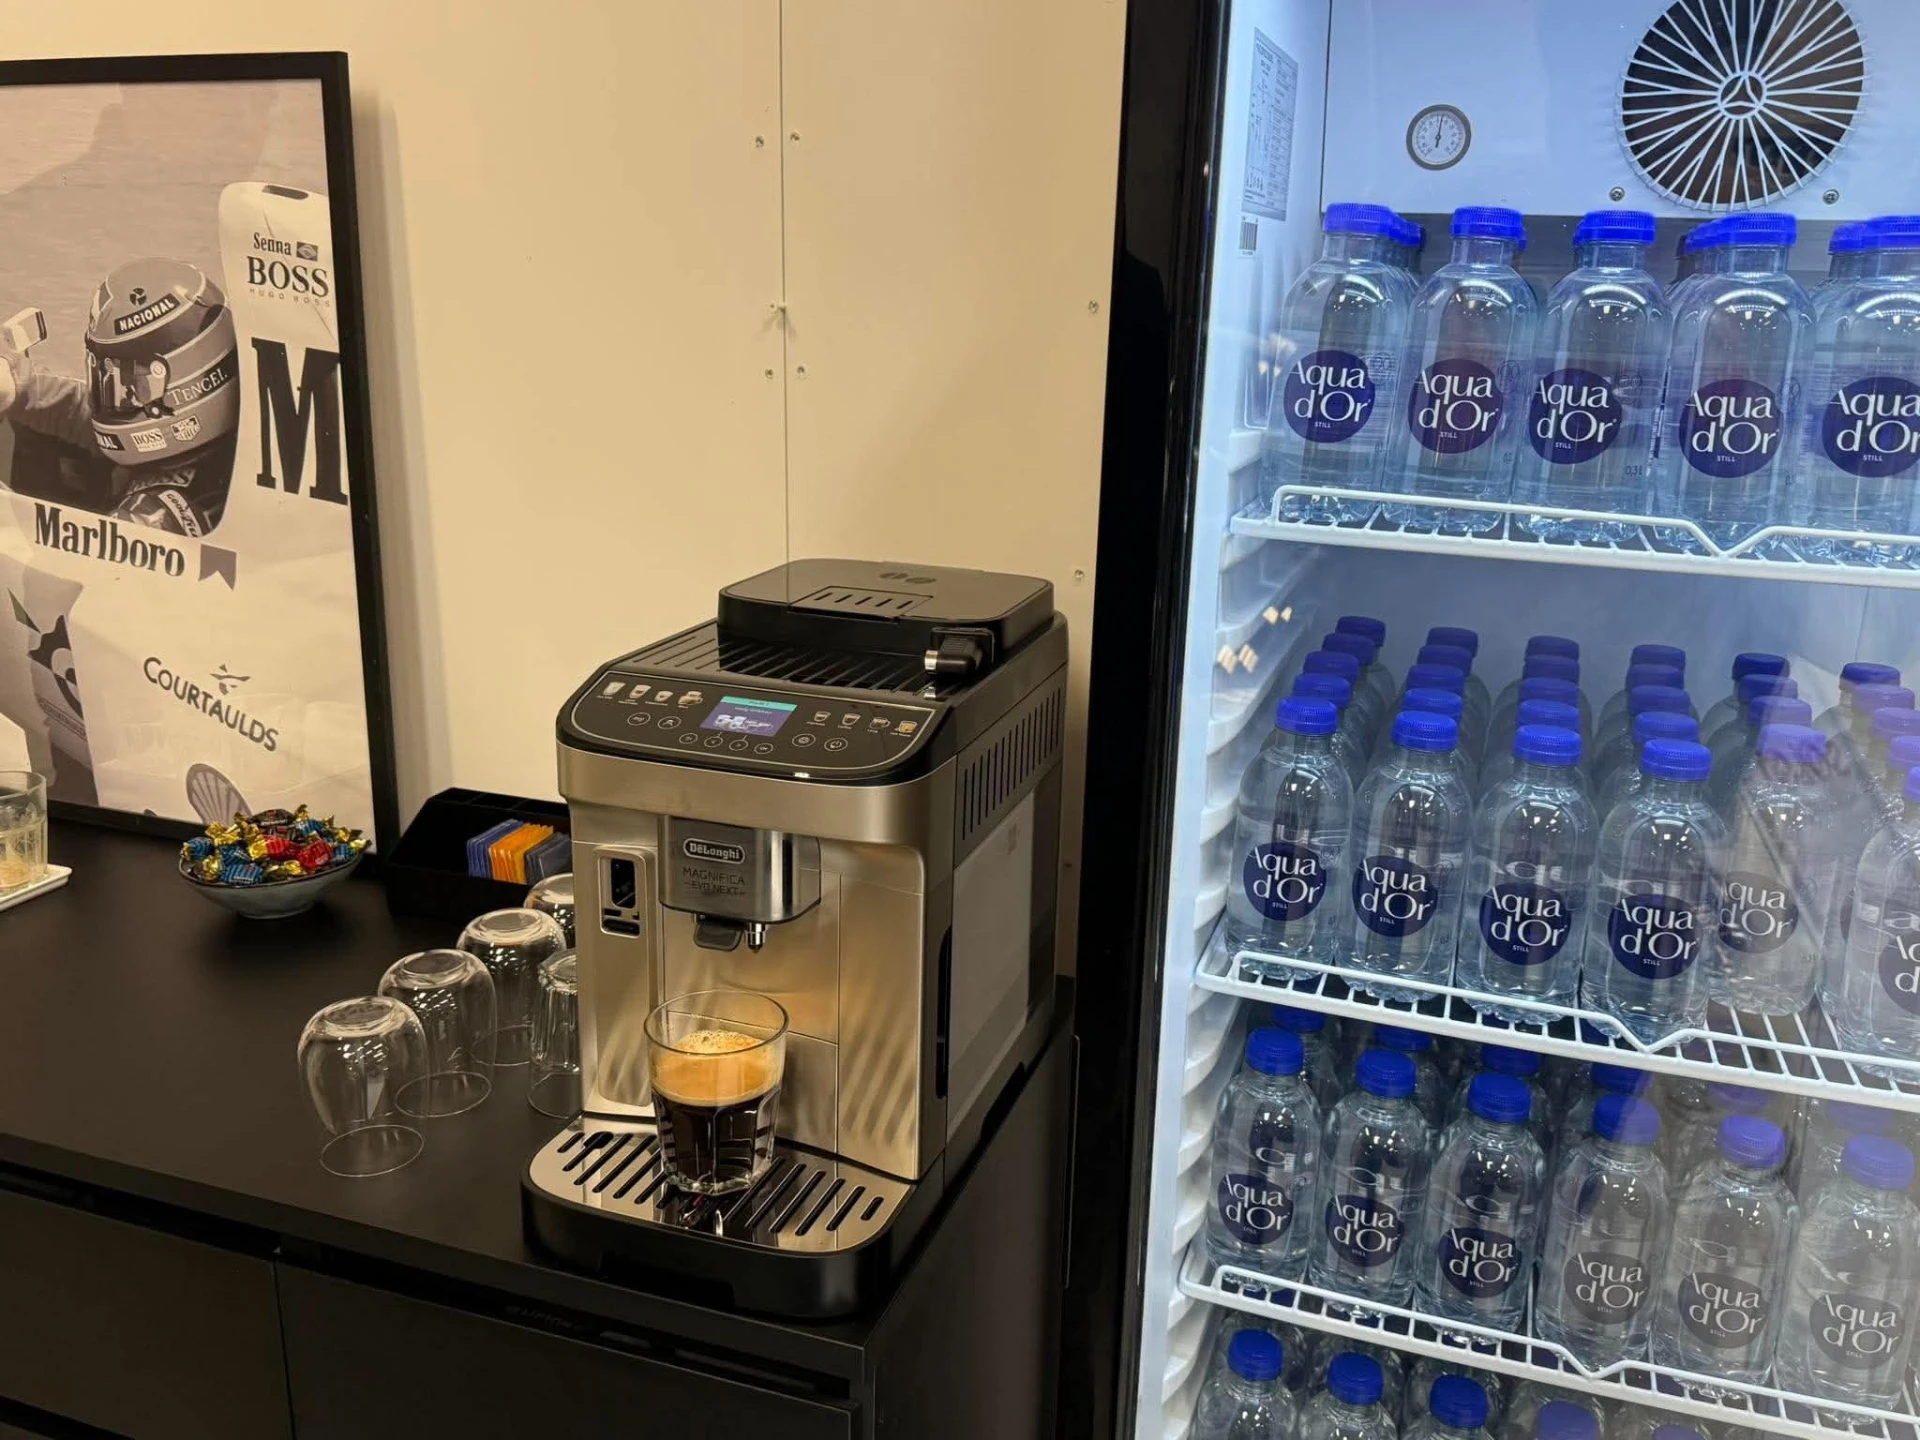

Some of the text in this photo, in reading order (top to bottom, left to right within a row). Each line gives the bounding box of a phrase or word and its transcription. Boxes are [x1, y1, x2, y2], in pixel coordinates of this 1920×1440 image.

[253, 232, 291, 256] Senna
[247, 256, 329, 297] BOSS
[119, 299, 176, 331] NACIONAL
[250, 288, 330, 308] HUGO BOSS
[1290, 360, 1366, 395] Aqua
[1415, 370, 1493, 405] Aqua
[1535, 379, 1610, 415] Aqua
[1685, 391, 1773, 428] Aqua
[133, 432, 164, 446] BOSS
[1315, 421, 1332, 429] STILL
[1440, 431, 1458, 439] STILL
[1555, 441, 1572, 450] STILL
[1717, 454, 1736, 463] STILL
[1863, 454, 1884, 462] STILL
[34, 502, 185, 578] Marlboro
[143, 657, 279, 752] COURTAULDS
[682, 866, 746, 886] MAGNIFICA
[1250, 847, 1317, 881] Aqua
[1359, 859, 1428, 894] Aqua
[1485, 886, 1563, 922] Aqua
[1615, 898, 1694, 935] Aqua
[1512, 944, 1529, 953] STILL
[1643, 958, 1661, 966] STILL
[1225, 1173, 1284, 1208] Aqua
[1333, 1195, 1395, 1230] Aqua
[1447, 1228, 1514, 1262] Aqua
[1574, 1253, 1643, 1287] Aqua
[1687, 1273, 1760, 1309] Aqua
[1823, 1294, 1897, 1330] Aqua
